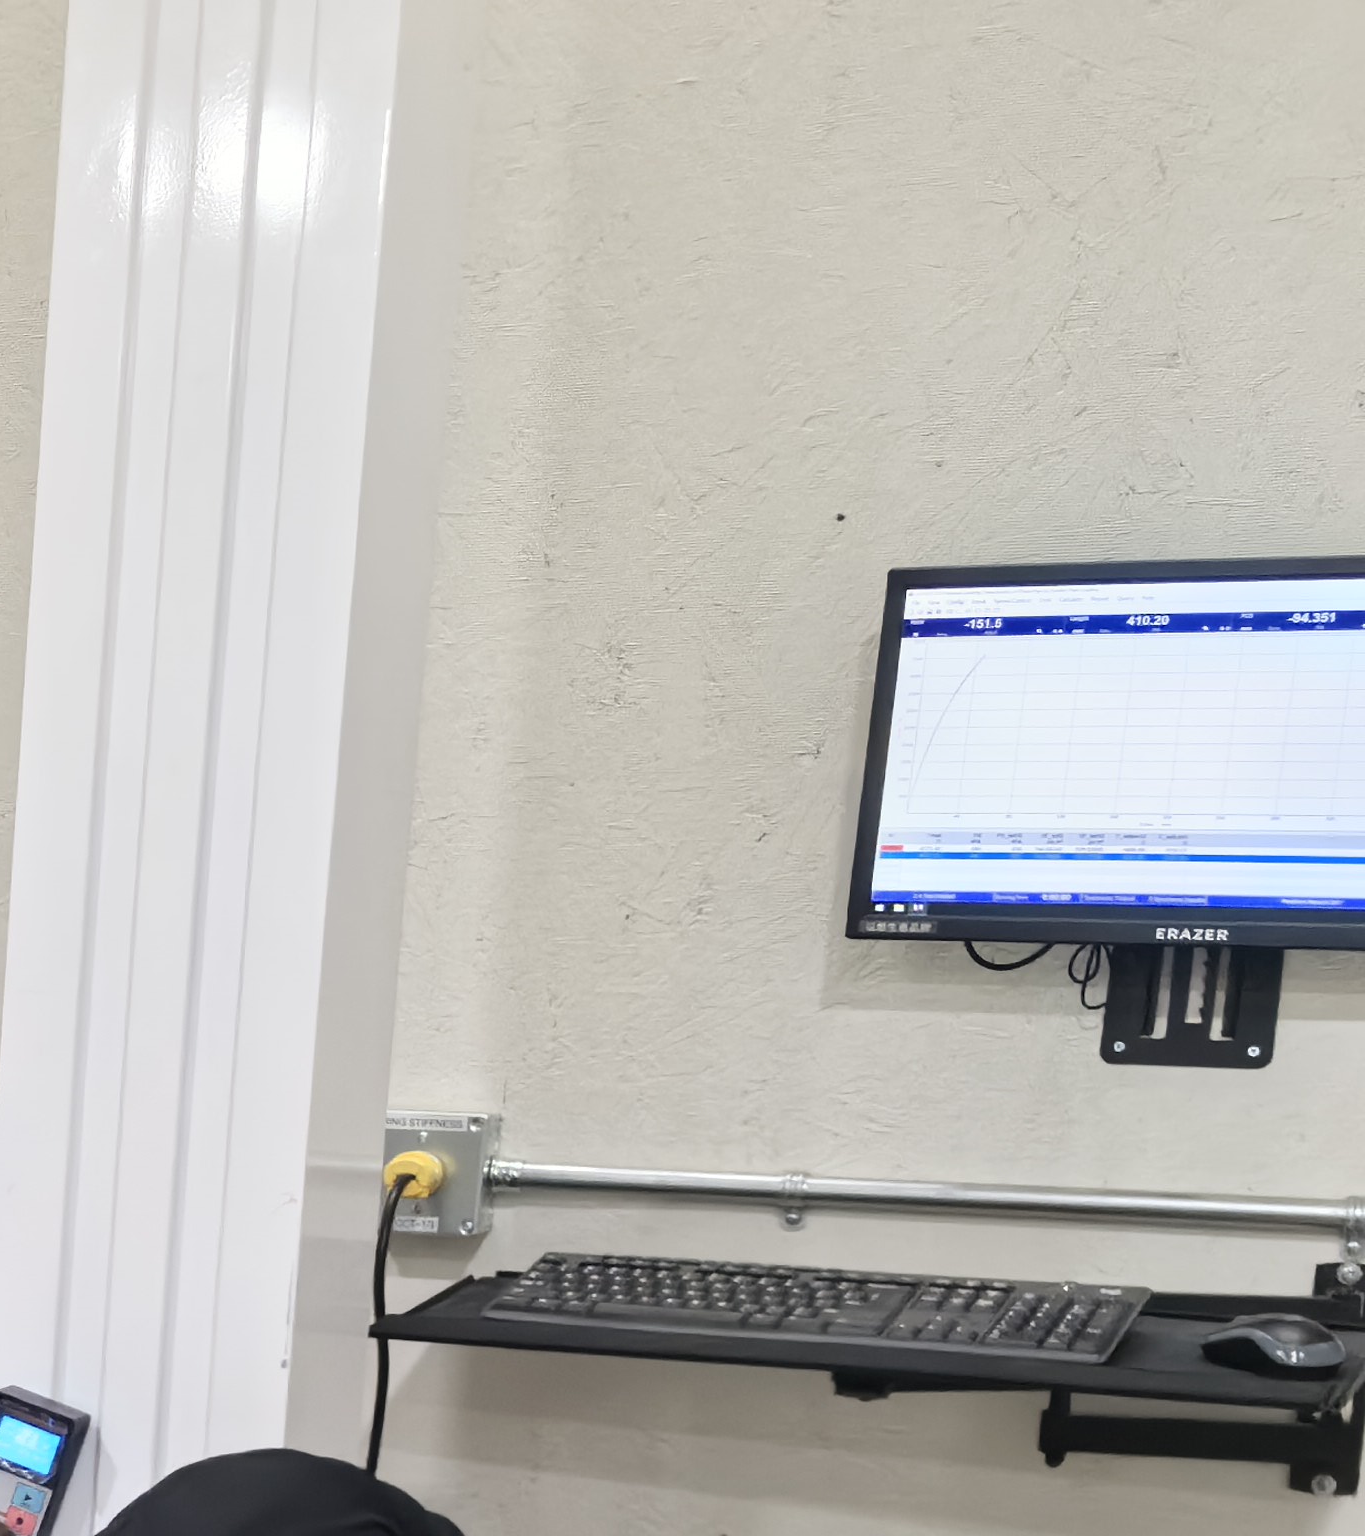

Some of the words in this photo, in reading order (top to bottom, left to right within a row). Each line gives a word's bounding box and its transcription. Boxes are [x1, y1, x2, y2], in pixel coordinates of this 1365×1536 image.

[1125, 615, 1170, 626] 410.20
[1286, 612, 1336, 623] -94.351
[1155, 927, 1230, 942] ERAZER
